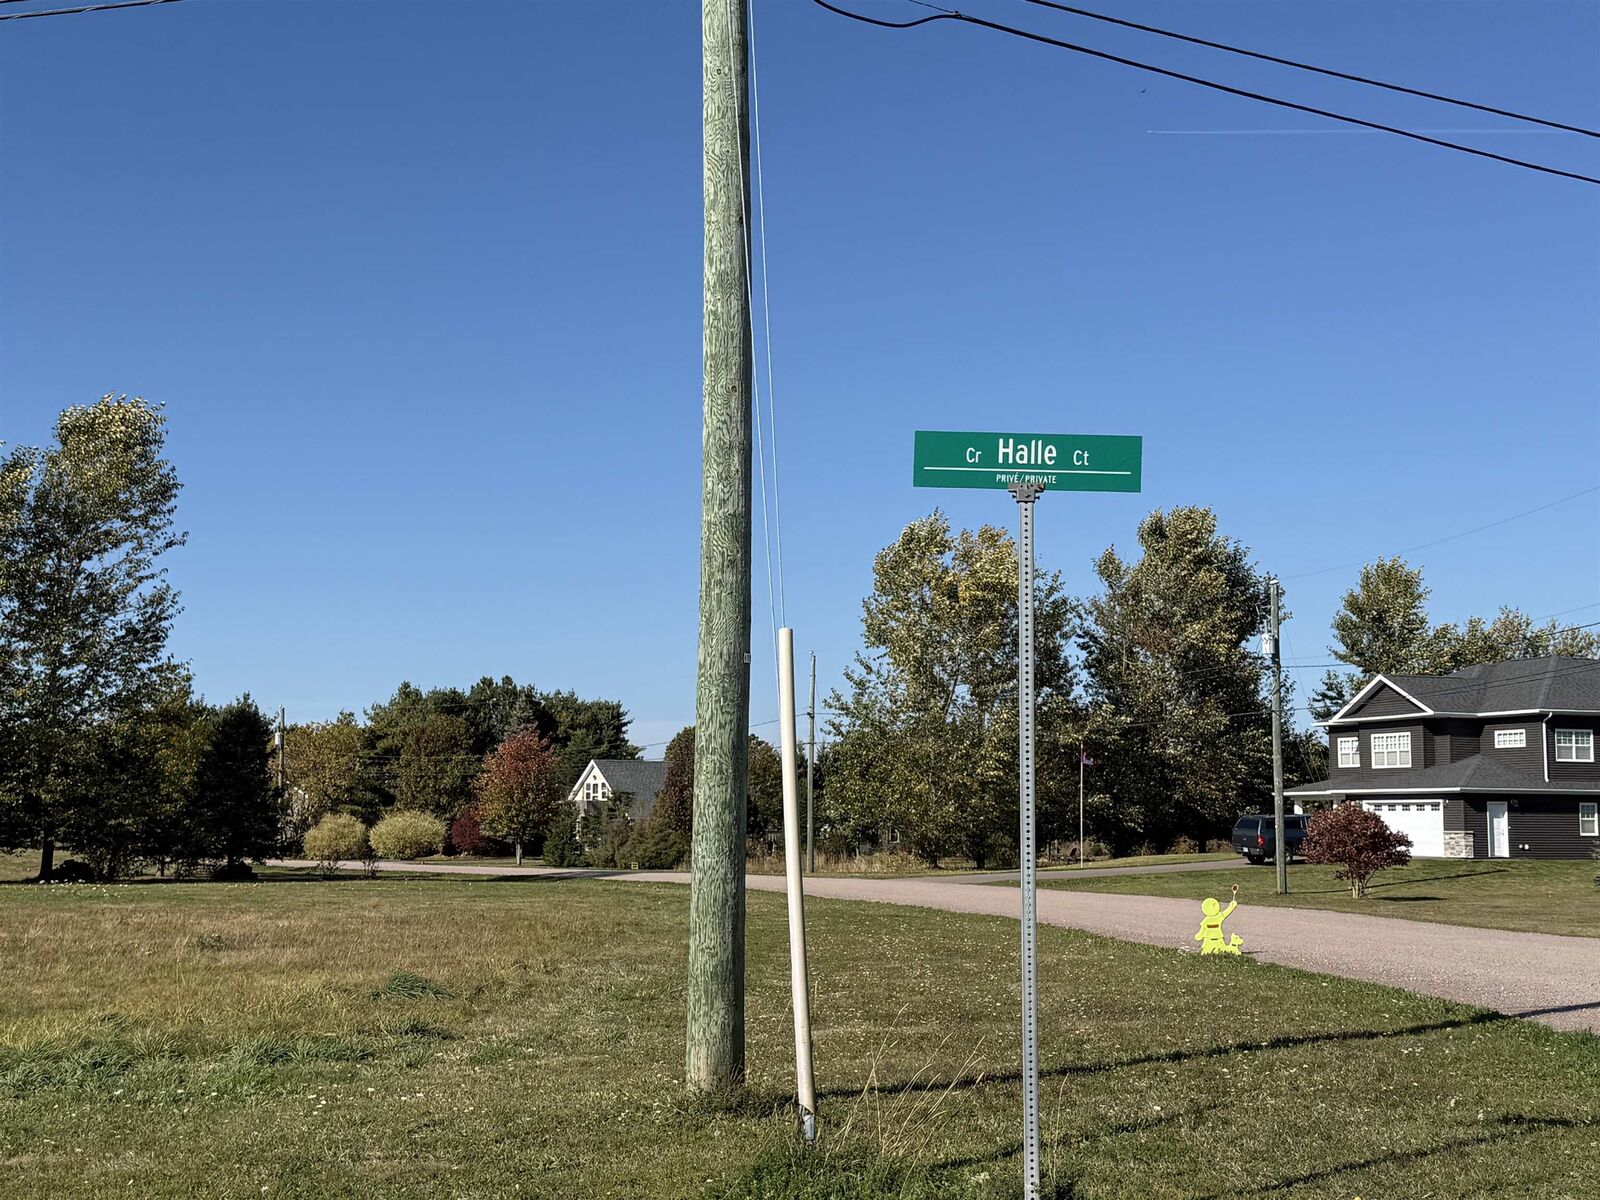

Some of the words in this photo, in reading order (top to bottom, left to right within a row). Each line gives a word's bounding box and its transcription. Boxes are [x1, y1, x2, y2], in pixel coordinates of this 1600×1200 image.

[966, 447, 981, 464] Cr
[998, 438, 1057, 465] Halle
[1073, 450, 1089, 466] Ct
